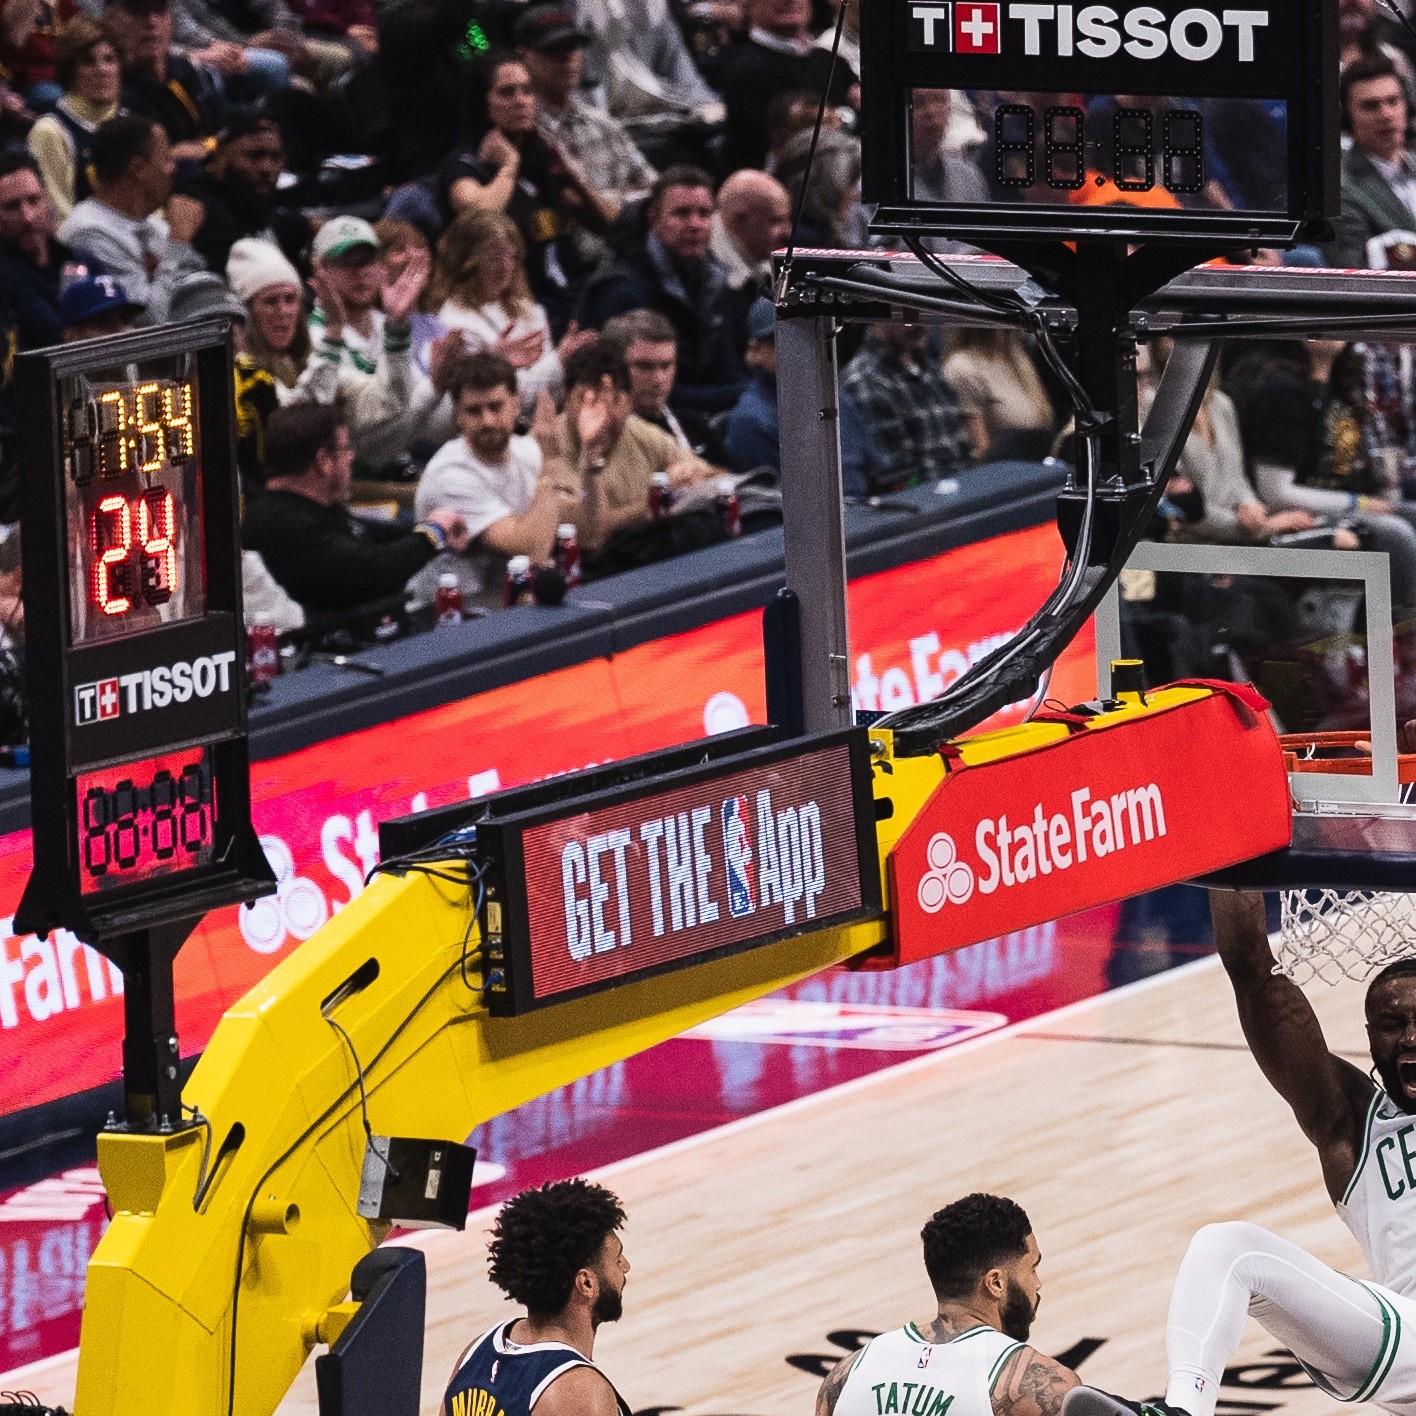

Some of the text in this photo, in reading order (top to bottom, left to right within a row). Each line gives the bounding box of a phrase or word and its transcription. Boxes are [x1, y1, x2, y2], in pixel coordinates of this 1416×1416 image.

[1008, 4, 1269, 62] TISSOT
[97, 492, 178, 615] 24
[119, 651, 236, 714] TISSOT
[560, 827, 634, 961] GET
[640, 805, 720, 937] THE
[756, 789, 826, 925] App
